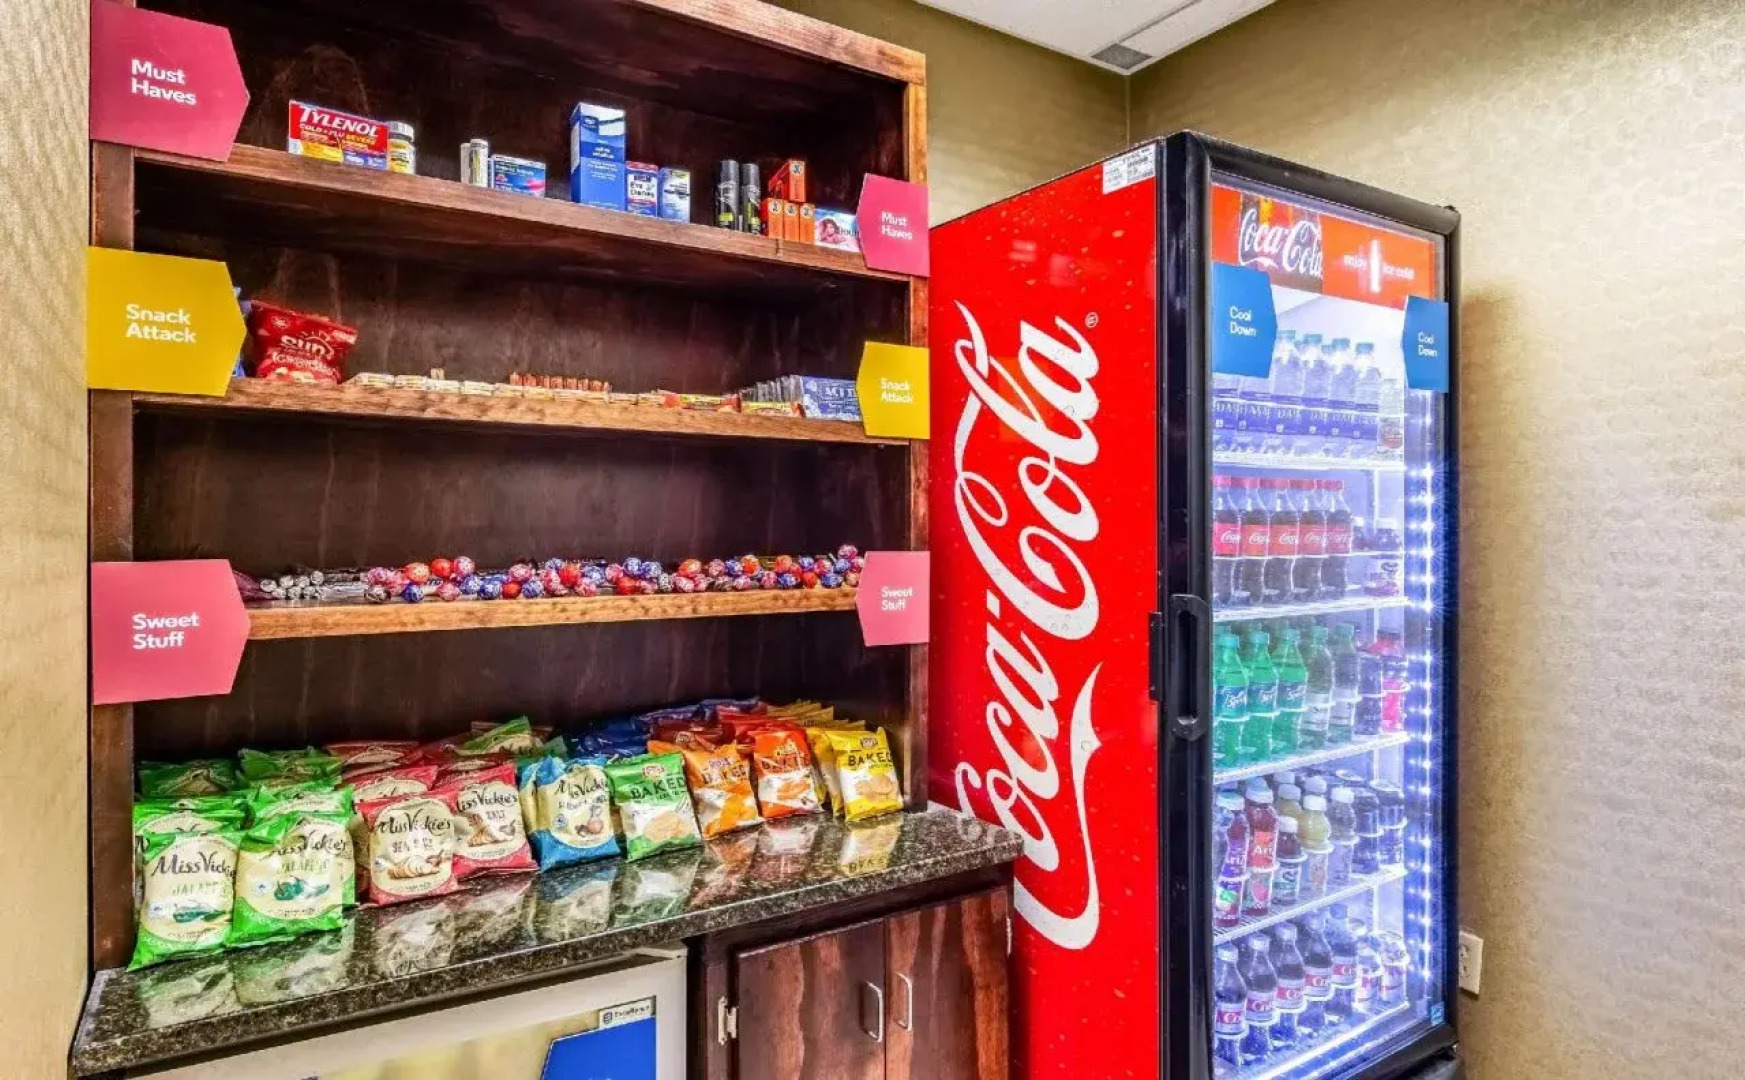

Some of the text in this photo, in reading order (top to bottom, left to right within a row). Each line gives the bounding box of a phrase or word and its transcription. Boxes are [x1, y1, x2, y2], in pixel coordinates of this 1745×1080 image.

[131, 59, 186, 85] Must
[131, 78, 197, 105] Haves
[299, 107, 380, 137] TYLENOL
[881, 210, 908, 227] Must
[881, 224, 914, 241] Haves
[126, 303, 191, 325] Snack
[1229, 305, 1252, 322] Cool
[126, 323, 197, 344] Attack
[1229, 320, 1257, 337] Down
[1417, 331, 1435, 344] Cool
[1417, 343, 1438, 358] Down
[880, 377, 911, 392] Snack
[880, 390, 913, 405] Attack
[881, 586, 914, 598] Sweet
[881, 599, 906, 611] Stuff
[132, 611, 199, 631] Sweet
[954, 297, 1101, 951] Coca-Cola
[132, 631, 185, 650] Stuff
[630, 776, 686, 800] BAKED
[151, 853, 200, 877] Miss
